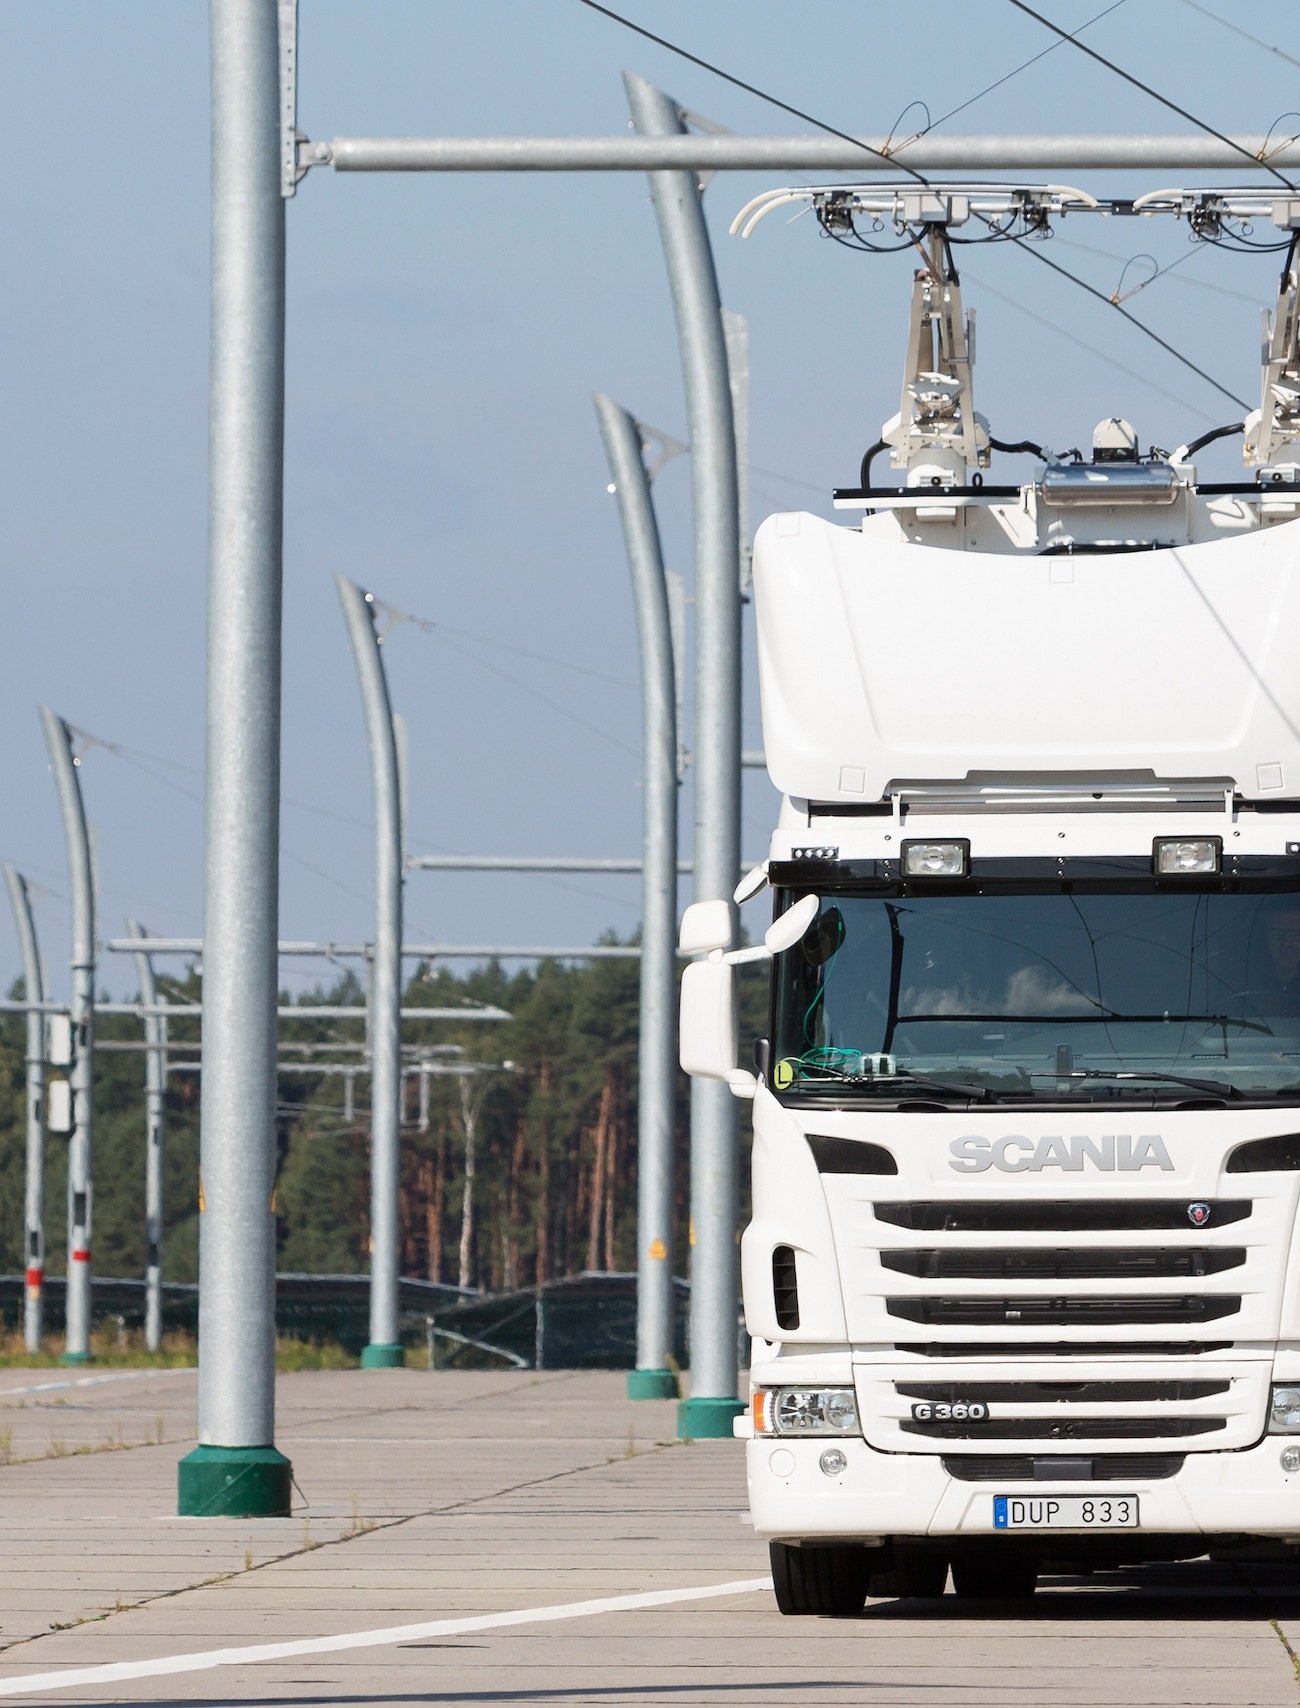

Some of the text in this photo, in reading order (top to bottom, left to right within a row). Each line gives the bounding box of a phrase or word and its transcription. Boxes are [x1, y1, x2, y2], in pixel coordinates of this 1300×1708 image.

[948, 1134, 1175, 1173] SCANIA
[915, 1404, 985, 1420] G 360
[1012, 1501, 1060, 1524] DUP
[1082, 1501, 1130, 1523] 833
